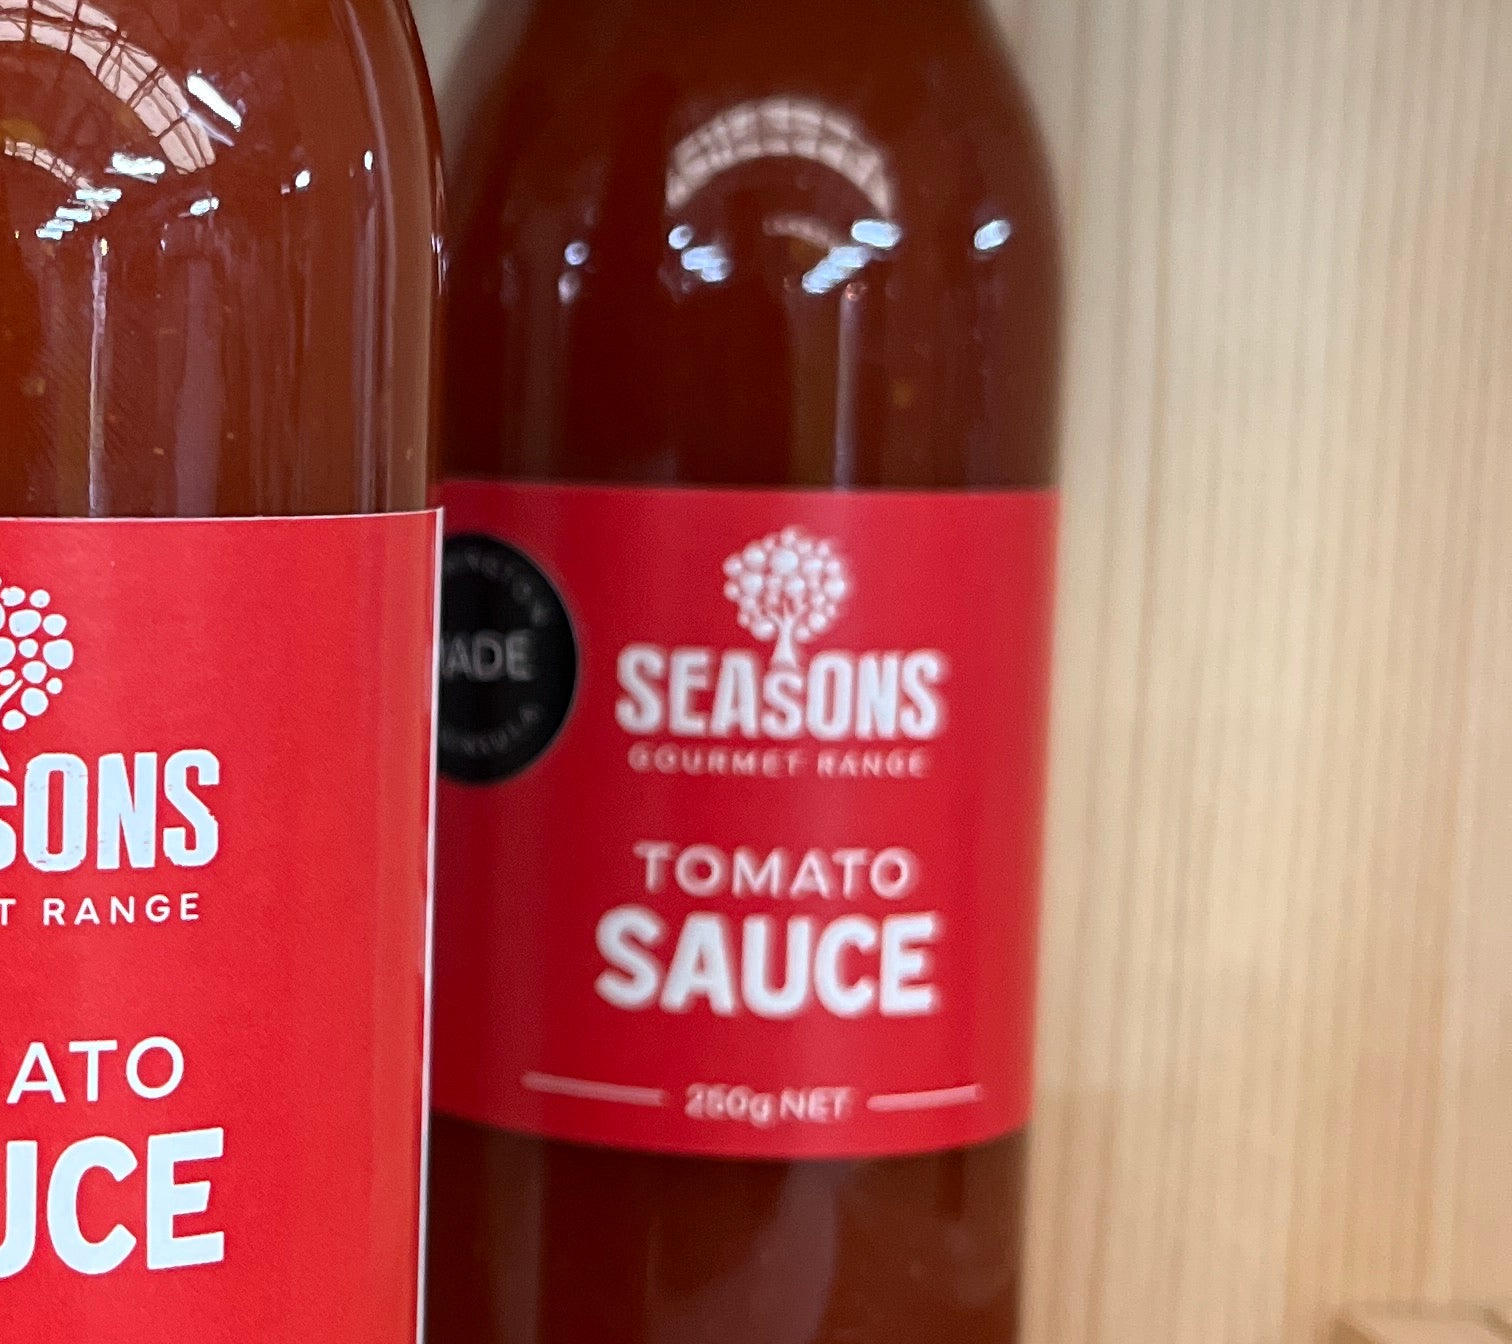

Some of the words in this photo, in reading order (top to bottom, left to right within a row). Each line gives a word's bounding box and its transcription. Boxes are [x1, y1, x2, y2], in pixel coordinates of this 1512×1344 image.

[439, 628, 535, 682] ADE
[614, 643, 944, 740] SEASONS
[629, 741, 800, 776] GOURMET
[817, 748, 928, 777] RANGE
[637, 842, 916, 899] TOMATO
[41, 892, 200, 926] RANGE
[596, 906, 941, 1017] SAUCE
[779, 1084, 850, 1122] NET
